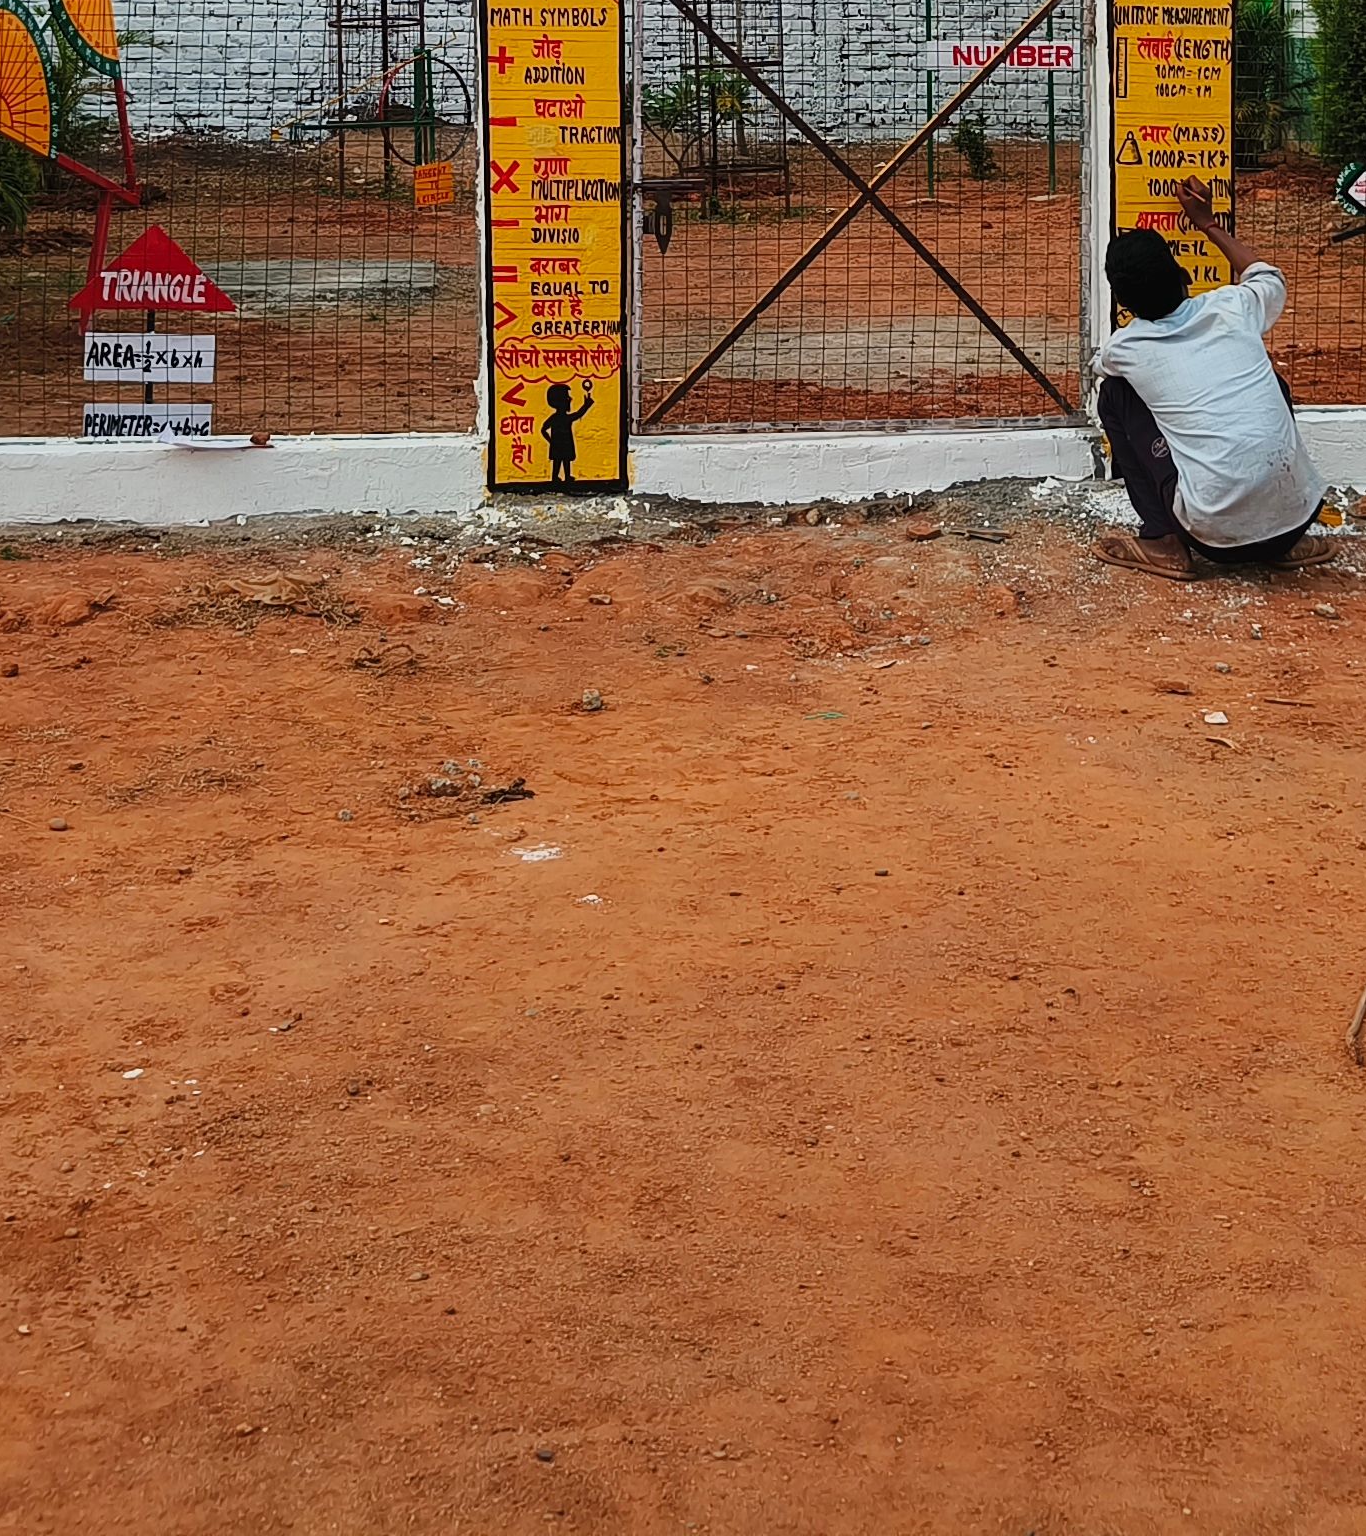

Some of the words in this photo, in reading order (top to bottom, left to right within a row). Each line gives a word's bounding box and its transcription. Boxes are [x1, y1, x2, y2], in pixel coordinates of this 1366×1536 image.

[490, 7, 533, 27] MATH
[540, 7, 608, 27] SYMBOLS
[531, 33, 564, 65] जोड़
[1137, 30, 1174, 65] लंबाई
[524, 63, 585, 85] ADDITION
[533, 94, 586, 119] घटाओ
[1139, 126, 1171, 147] भार
[1173, 123, 1225, 144] (MASS)
[533, 157, 572, 180] गुणा
[535, 204, 571, 225] भाग
[529, 257, 582, 276] बराबर
[100, 269, 207, 304] TRIANGLE
[531, 281, 584, 296] EQUAL
[589, 280, 610, 295] TO
[531, 298, 564, 320] बड़ा
[569, 294, 584, 322] है
[497, 344, 541, 369] सोचो
[541, 345, 589, 372] समझो
